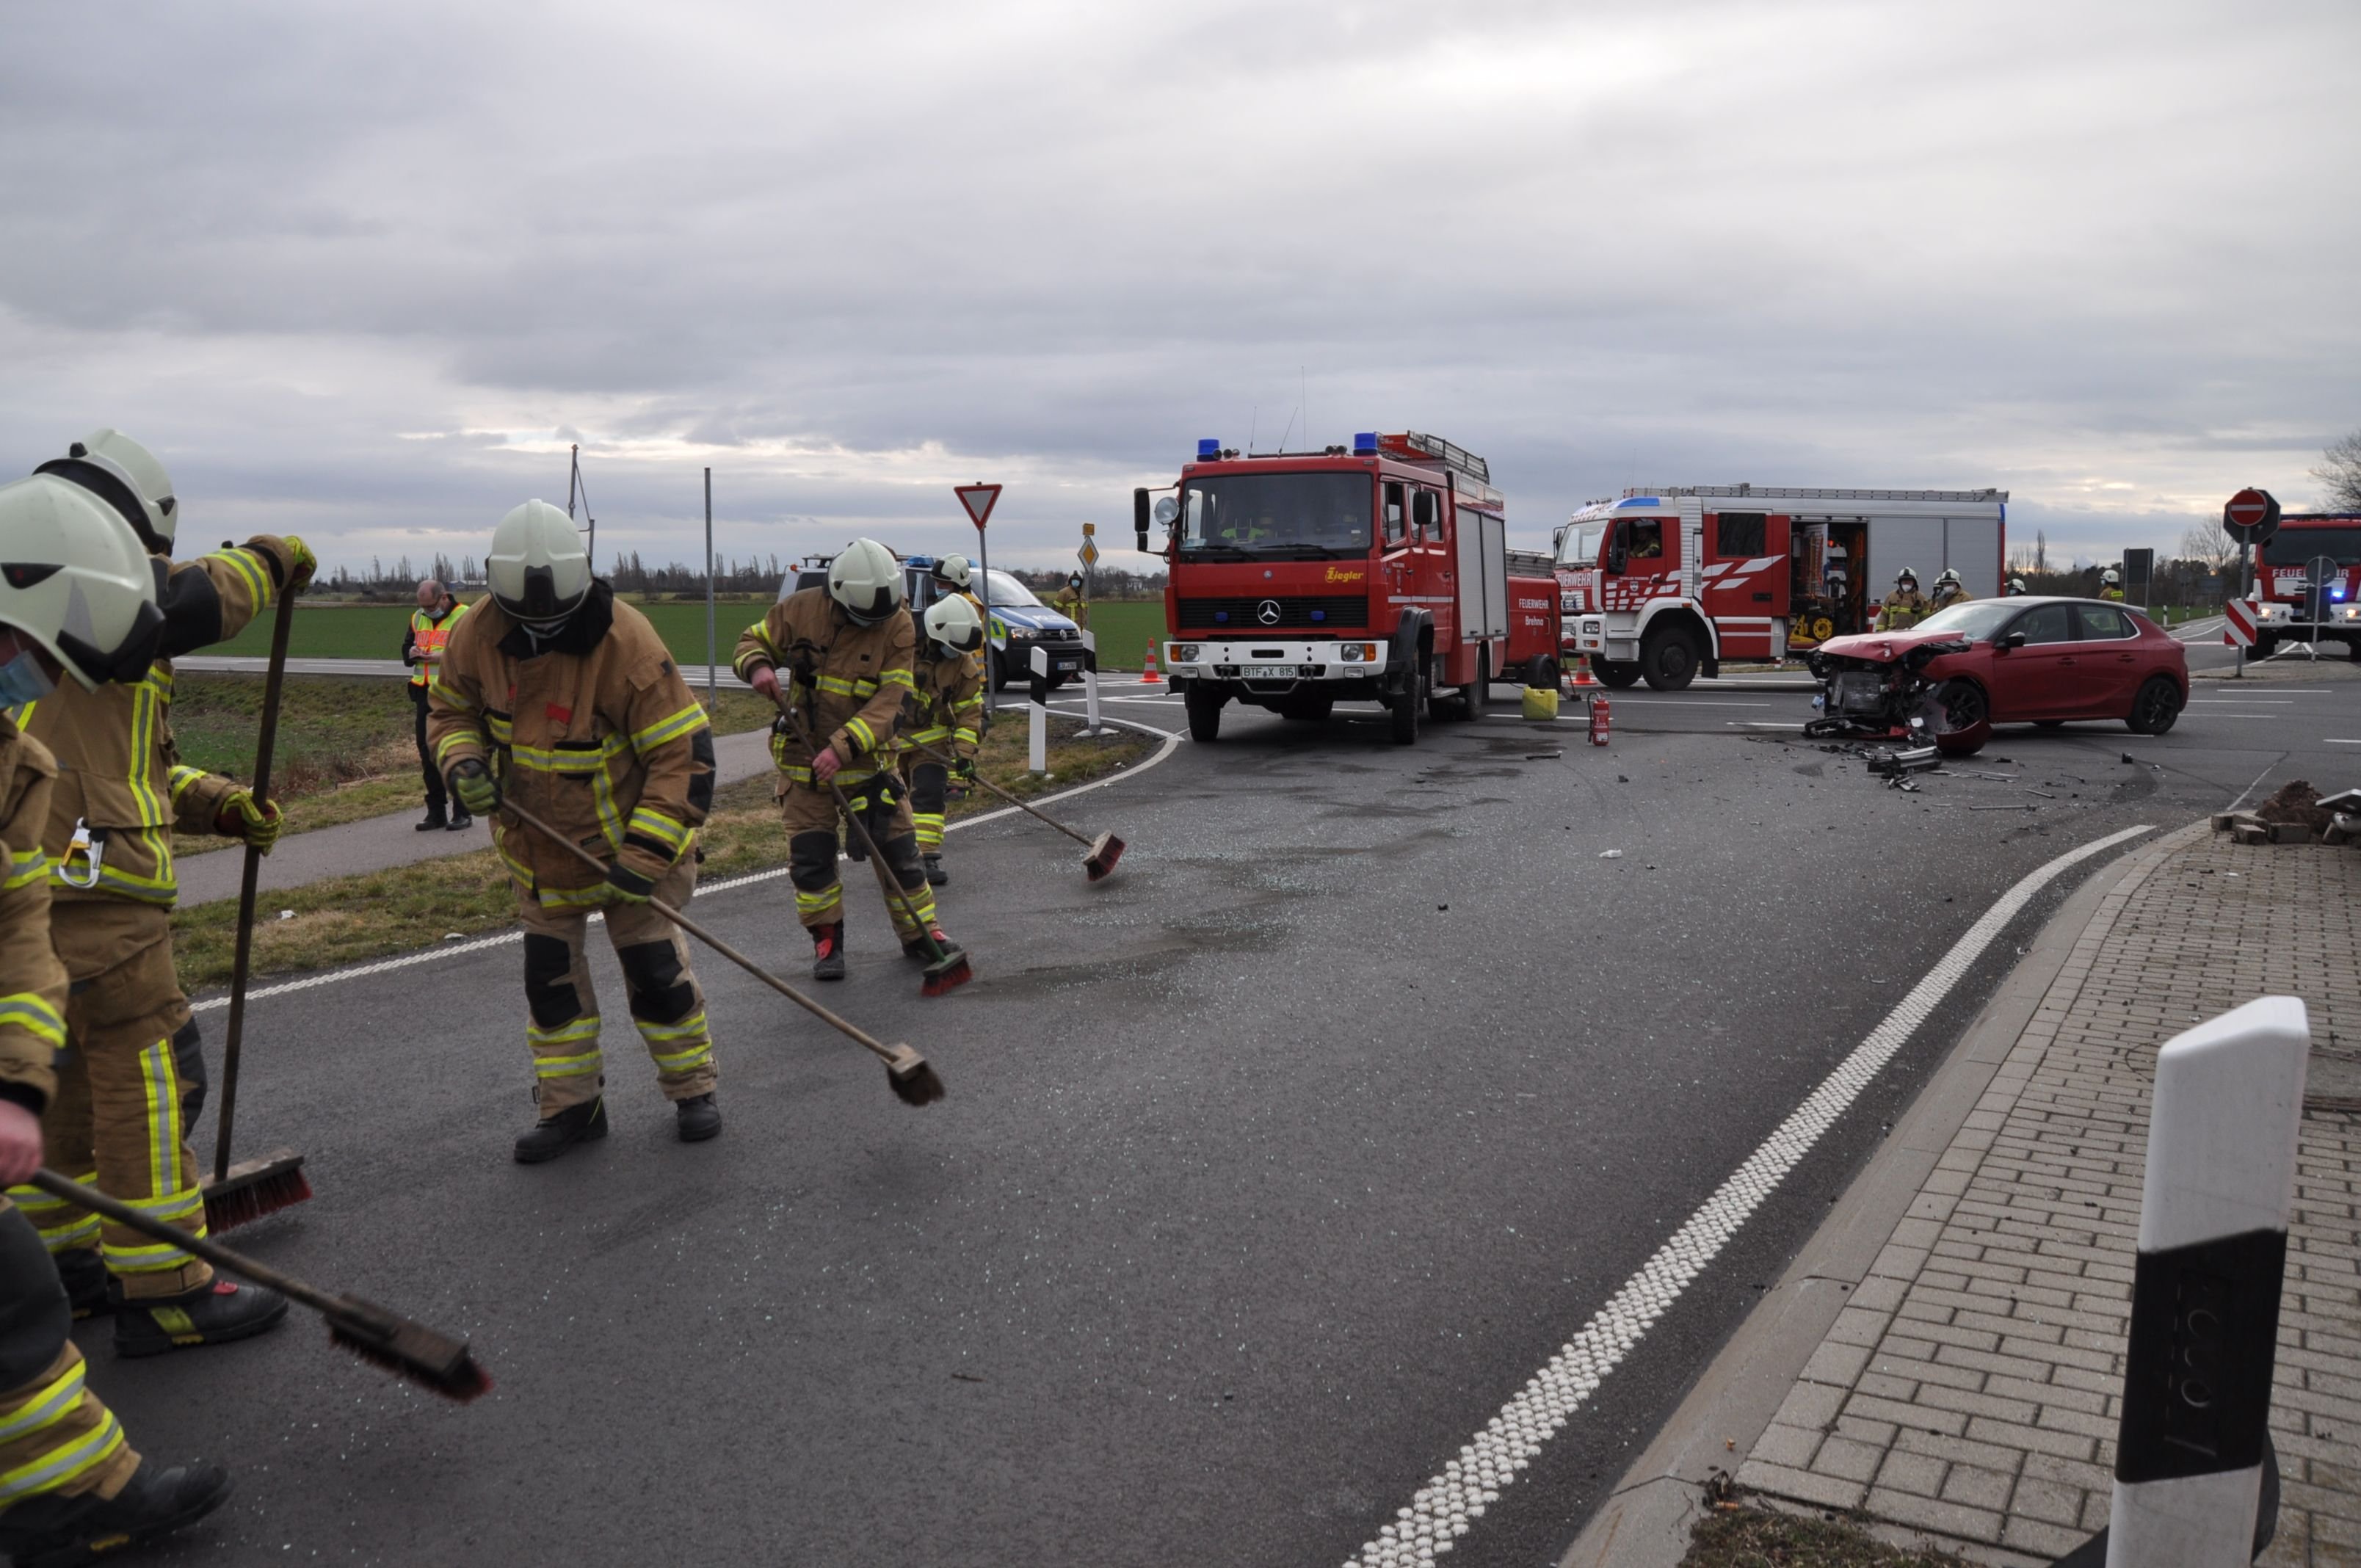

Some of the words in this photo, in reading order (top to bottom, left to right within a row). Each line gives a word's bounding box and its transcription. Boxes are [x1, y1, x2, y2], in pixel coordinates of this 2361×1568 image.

[1325, 567, 1364, 583] Ziegler
[1519, 598, 1549, 609] FEUERWEHR
[1244, 667, 1263, 677] BTF
[1268, 667, 1274, 677] X
[1279, 667, 1294, 677] 815
